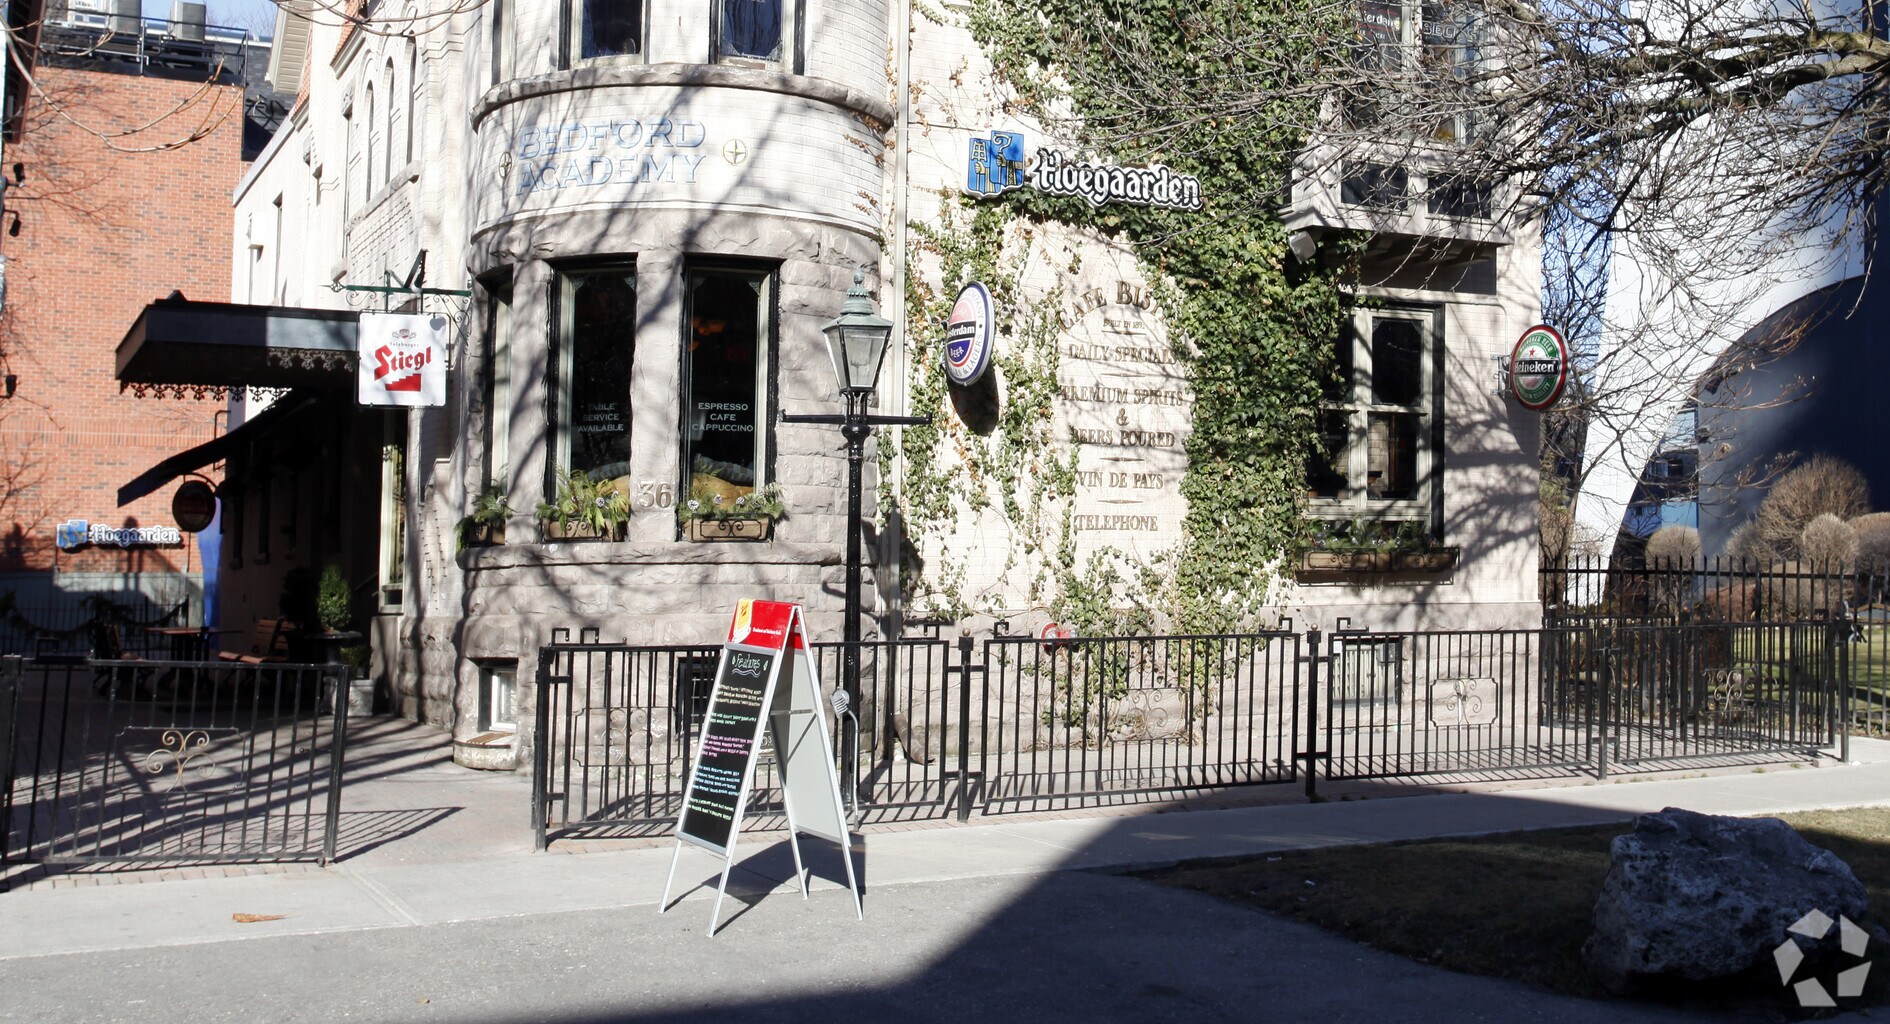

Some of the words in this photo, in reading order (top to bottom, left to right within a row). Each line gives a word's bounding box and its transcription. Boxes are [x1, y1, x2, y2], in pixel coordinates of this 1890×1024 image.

[518, 118, 706, 159] BEDFORD
[516, 153, 706, 196] ACADEMY
[1034, 148, 1201, 207] Hoegaarden
[374, 344, 432, 382] Stiegl
[1068, 344, 1109, 361] DAILY
[1114, 346, 1177, 365] SPECIALS
[1514, 360, 1555, 373] Heineken
[1062, 386, 1128, 403] PREMIUM
[1133, 388, 1184, 406] SPIRITS
[698, 402, 748, 411] ESPRESSO
[583, 413, 619, 421] SERVICE
[710, 413, 736, 421] CAFE
[1116, 408, 1129, 426] &
[578, 424, 624, 432] AVAILABLE
[692, 424, 753, 432] CAPPUCCINO
[1120, 430, 1175, 447] POURED
[1078, 471, 1103, 487] VIN
[1109, 473, 1127, 488] DE
[1133, 474, 1163, 489] PAYS
[637, 481, 672, 508] 36
[1077, 515, 1158, 531] TELEPHONE
[90, 524, 180, 545] Hoegaarden
